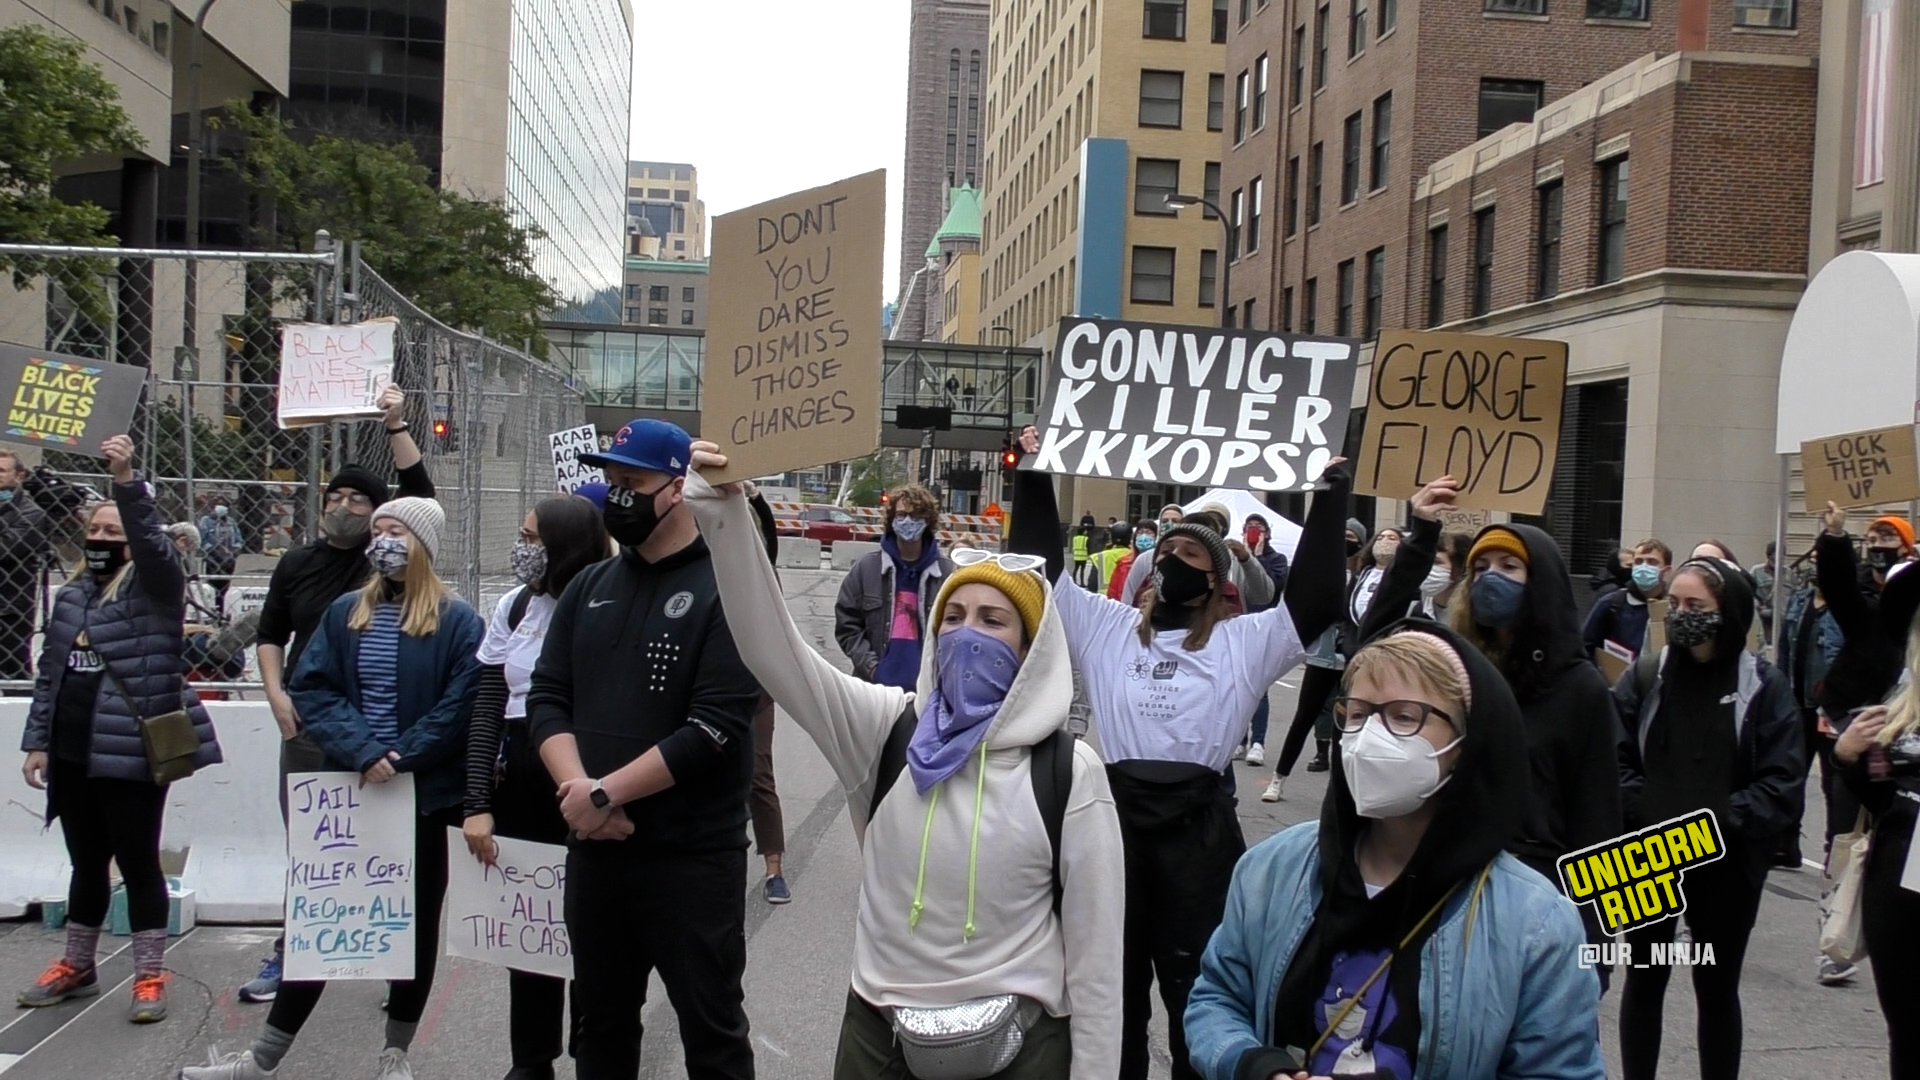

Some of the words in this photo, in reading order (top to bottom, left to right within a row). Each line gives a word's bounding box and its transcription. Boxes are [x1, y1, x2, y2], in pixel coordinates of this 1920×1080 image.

[755, 196, 848, 255] DONT
[766, 246, 832, 300] YOU
[758, 288, 835, 332] DARE
[293, 330, 377, 358] BLACK
[734, 319, 850, 377] DISMISS
[1061, 322, 1350, 396] CONVICT
[22, 365, 101, 395] BLACK
[290, 356, 366, 379] LIVES
[752, 358, 843, 401] THOSE
[1375, 343, 1547, 422] GEORGE
[13, 385, 94, 418] LIVES
[284, 373, 389, 404] MATTER
[7, 409, 86, 437] MATTER
[731, 390, 855, 445] CHARGES
[1050, 378, 1332, 445] KILLER
[553, 428, 592, 449] ACAB
[616, 427, 632, 445] C
[1824, 434, 1886, 461] LOCK
[555, 443, 594, 465] ACAB
[1032, 427, 1331, 491] KKKOPS!
[1373, 422, 1543, 495] FLOYD
[1827, 457, 1891, 481] THEM
[561, 475, 600, 495] ACB
[608, 487, 635, 508] 46
[1848, 479, 1873, 499] UP
[1141, 685, 1180, 693] JUSTICE
[1138, 702, 1177, 710] GEORGE
[293, 778, 360, 813] JAIL
[314, 814, 356, 841] ALL
[291, 856, 357, 887] KILLER
[369, 895, 413, 920] ALL
[316, 928, 392, 954] CASES
[462, 915, 513, 950] THE
[520, 925, 568, 957] CAS
